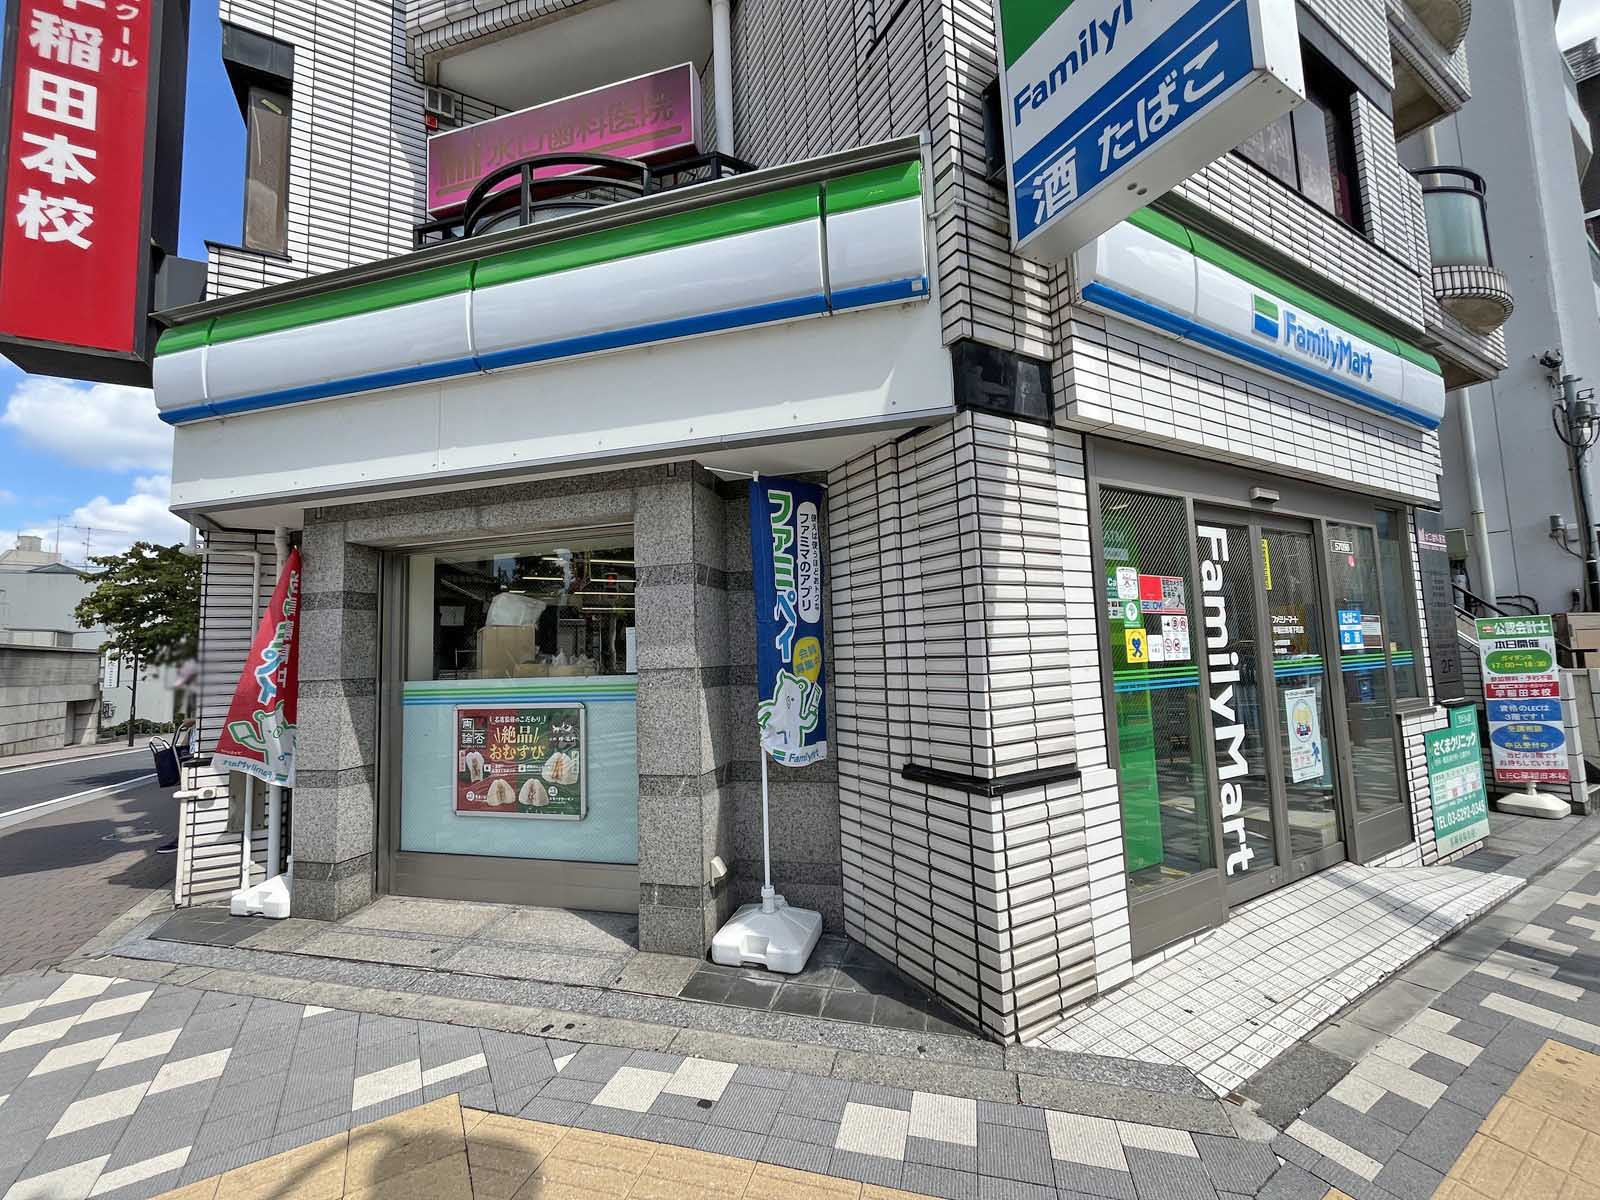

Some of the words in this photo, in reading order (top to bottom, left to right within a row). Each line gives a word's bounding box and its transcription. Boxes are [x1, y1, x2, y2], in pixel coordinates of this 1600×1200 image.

[112, 0, 139, 68] クール
[1032, 146, 1079, 226] 酒
[1097, 39, 1226, 173] たばこ
[1283, 309, 1373, 380] FamilyMart
[798, 512, 812, 612] ファミマのアプリ
[767, 489, 798, 664] ファミペイ
[1494, 620, 1550, 635] 公認会計士
[1495, 639, 1540, 649] 本日開催
[1439, 659, 1455, 674] 2F
[1196, 525, 1255, 876] FamilyMart
[1495, 688, 1552, 697] 早稲田本校
[501, 725, 533, 744] 絶品
[1432, 730, 1476, 757] さくまクリニック
[488, 743, 545, 760] おむすび
[788, 748, 822, 763] Family
